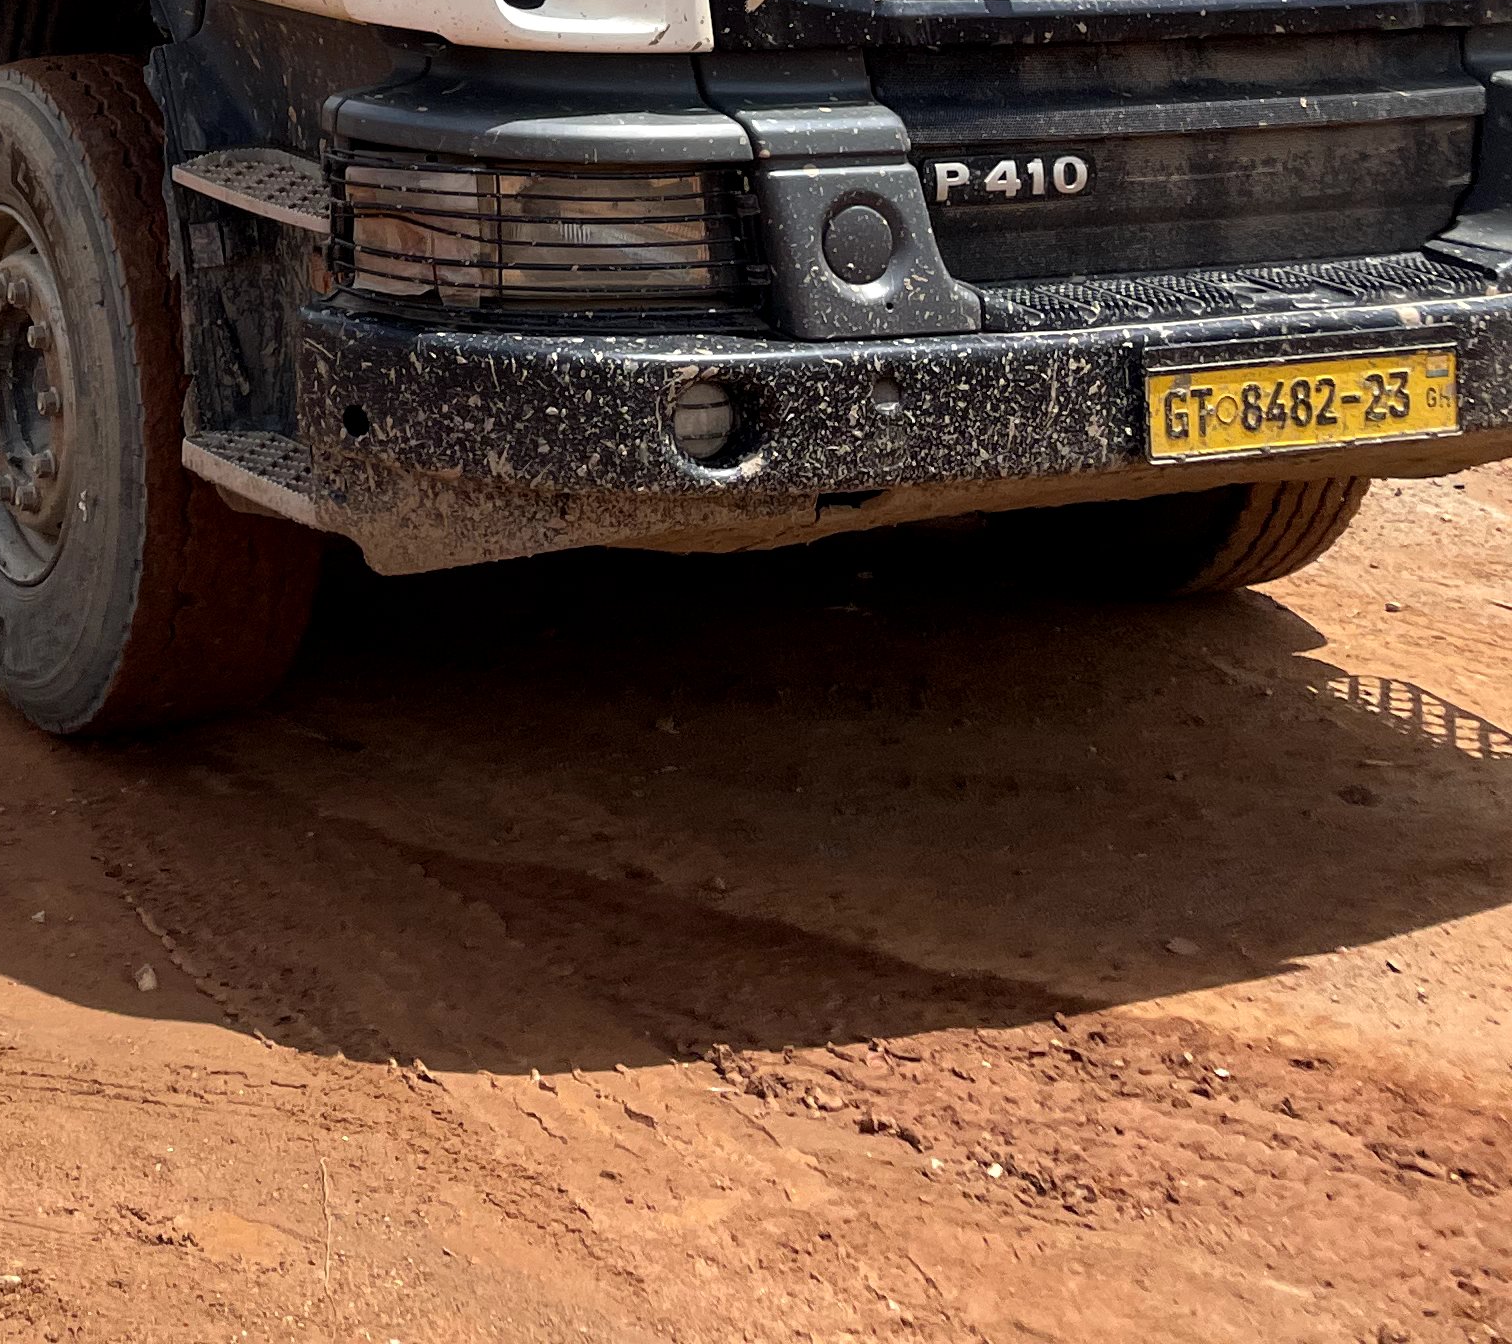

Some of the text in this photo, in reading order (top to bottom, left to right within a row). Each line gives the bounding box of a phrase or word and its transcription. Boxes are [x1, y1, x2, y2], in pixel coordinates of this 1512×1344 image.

[935, 155, 1088, 202] P 410
[1240, 369, 1411, 433] 8482-23
